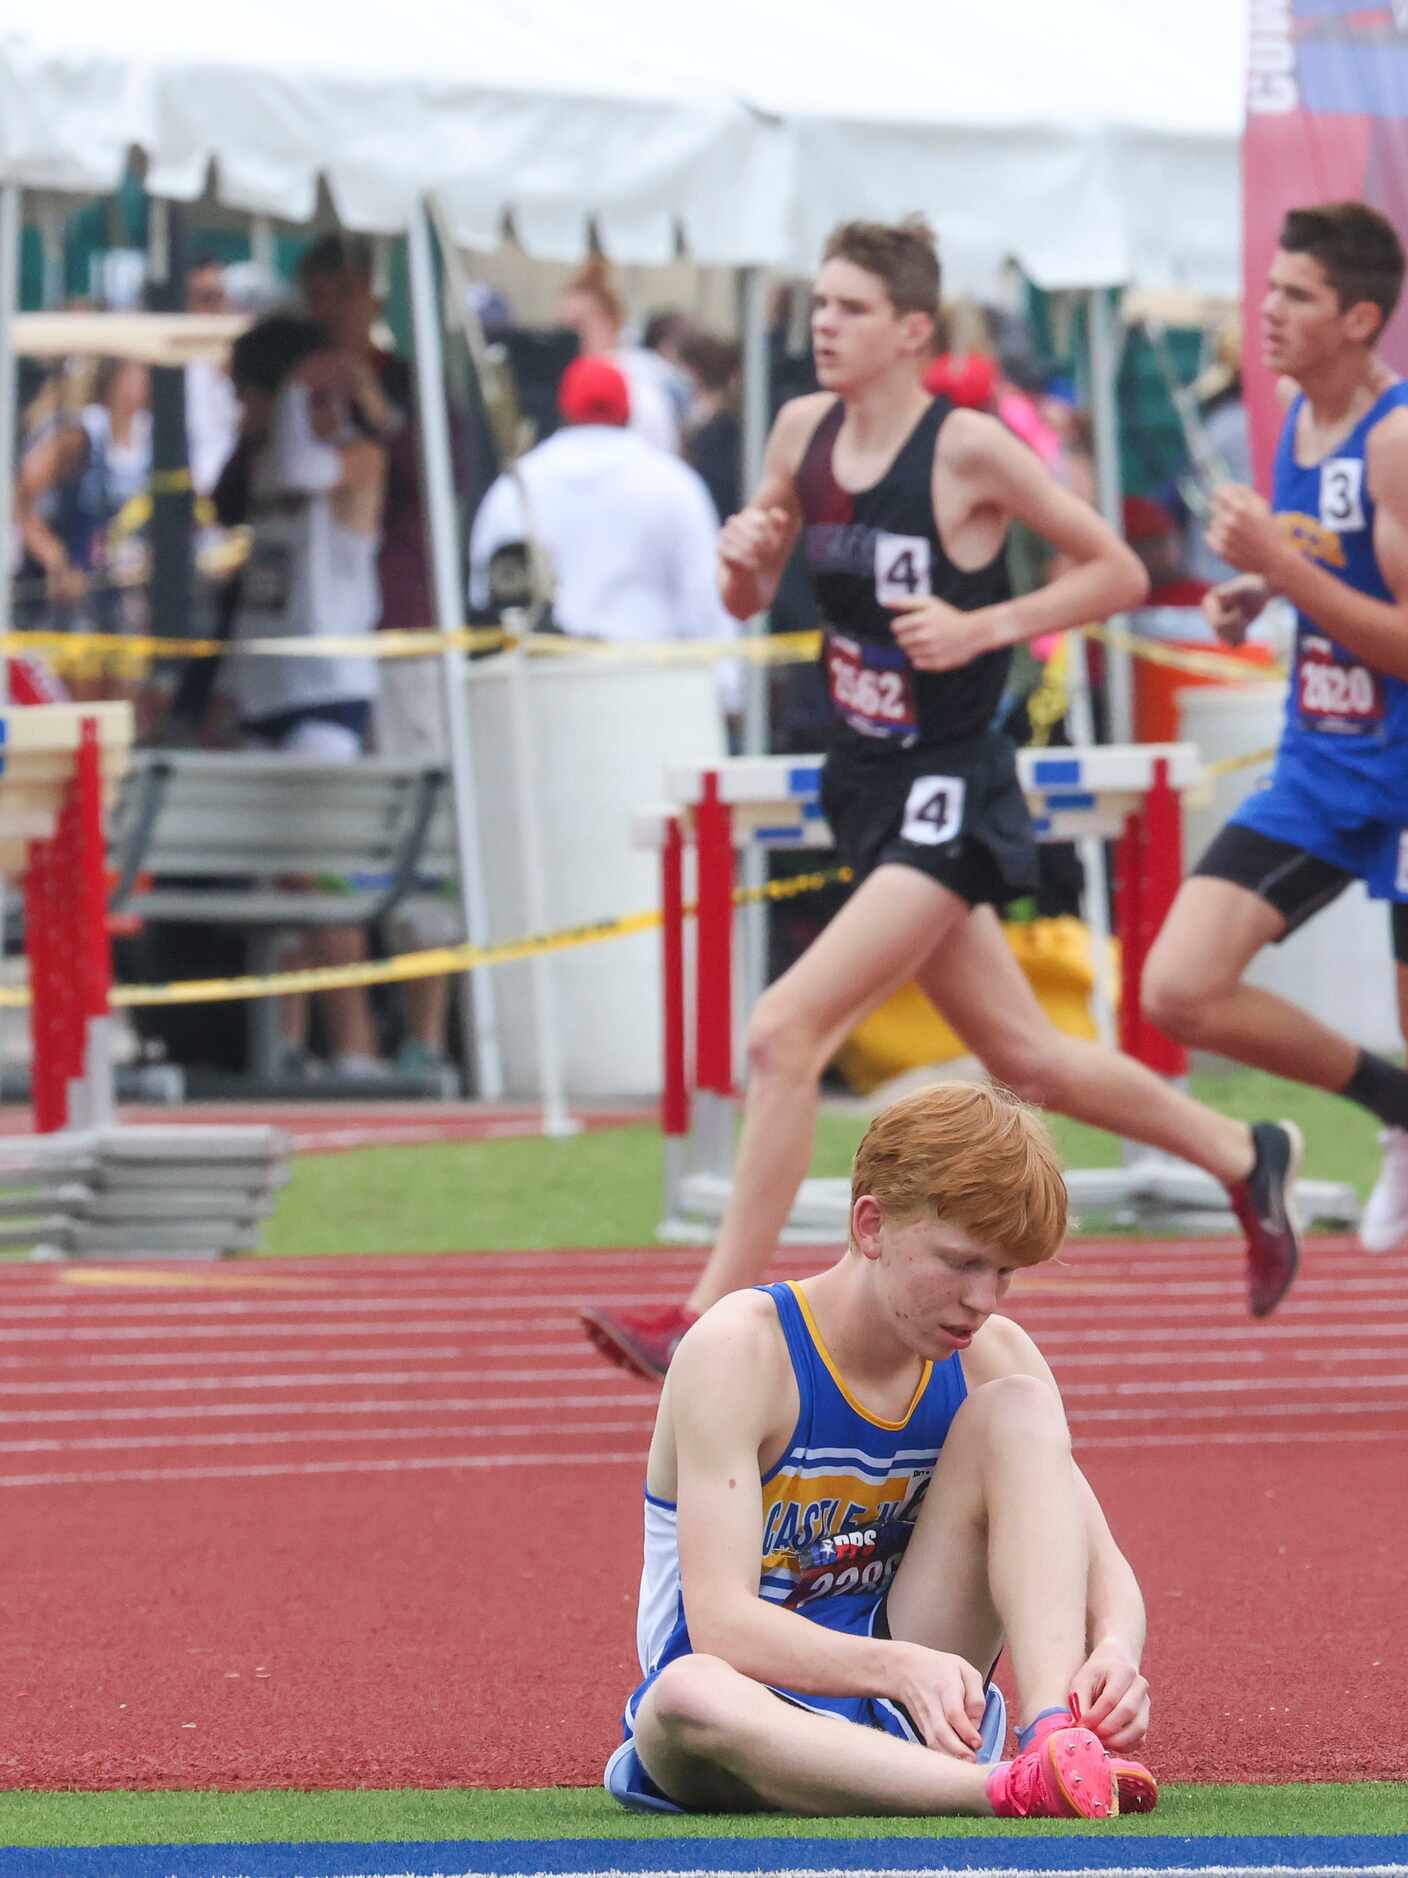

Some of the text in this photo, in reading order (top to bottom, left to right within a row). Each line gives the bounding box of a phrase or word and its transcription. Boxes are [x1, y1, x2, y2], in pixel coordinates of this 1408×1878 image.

[1329, 471, 1352, 519] 3
[887, 550, 919, 594] 4
[915, 792, 948, 833] 4
